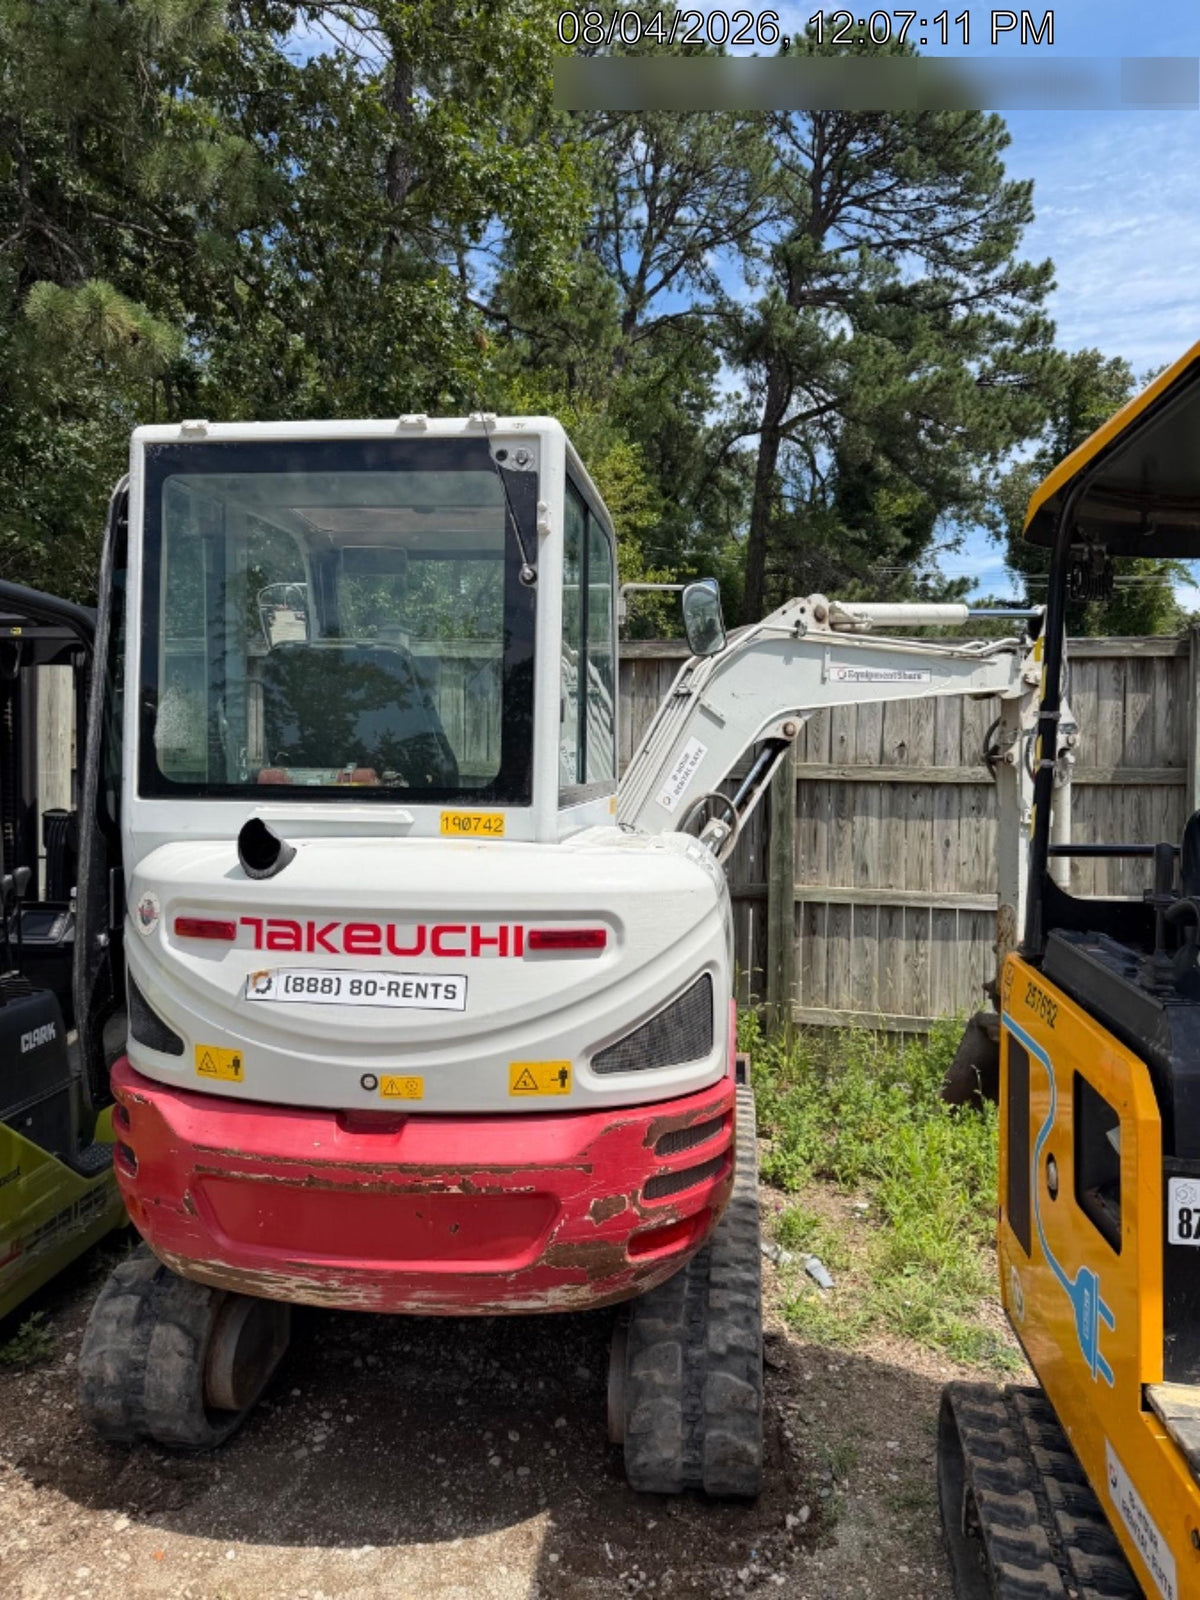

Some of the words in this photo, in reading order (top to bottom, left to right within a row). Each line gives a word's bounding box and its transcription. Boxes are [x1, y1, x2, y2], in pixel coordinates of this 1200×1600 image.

[442, 815, 504, 833] 190742
[284, 975, 342, 996] (888)
[350, 979, 458, 1000] 80-RENTS
[21, 1021, 56, 1053] CLARK
